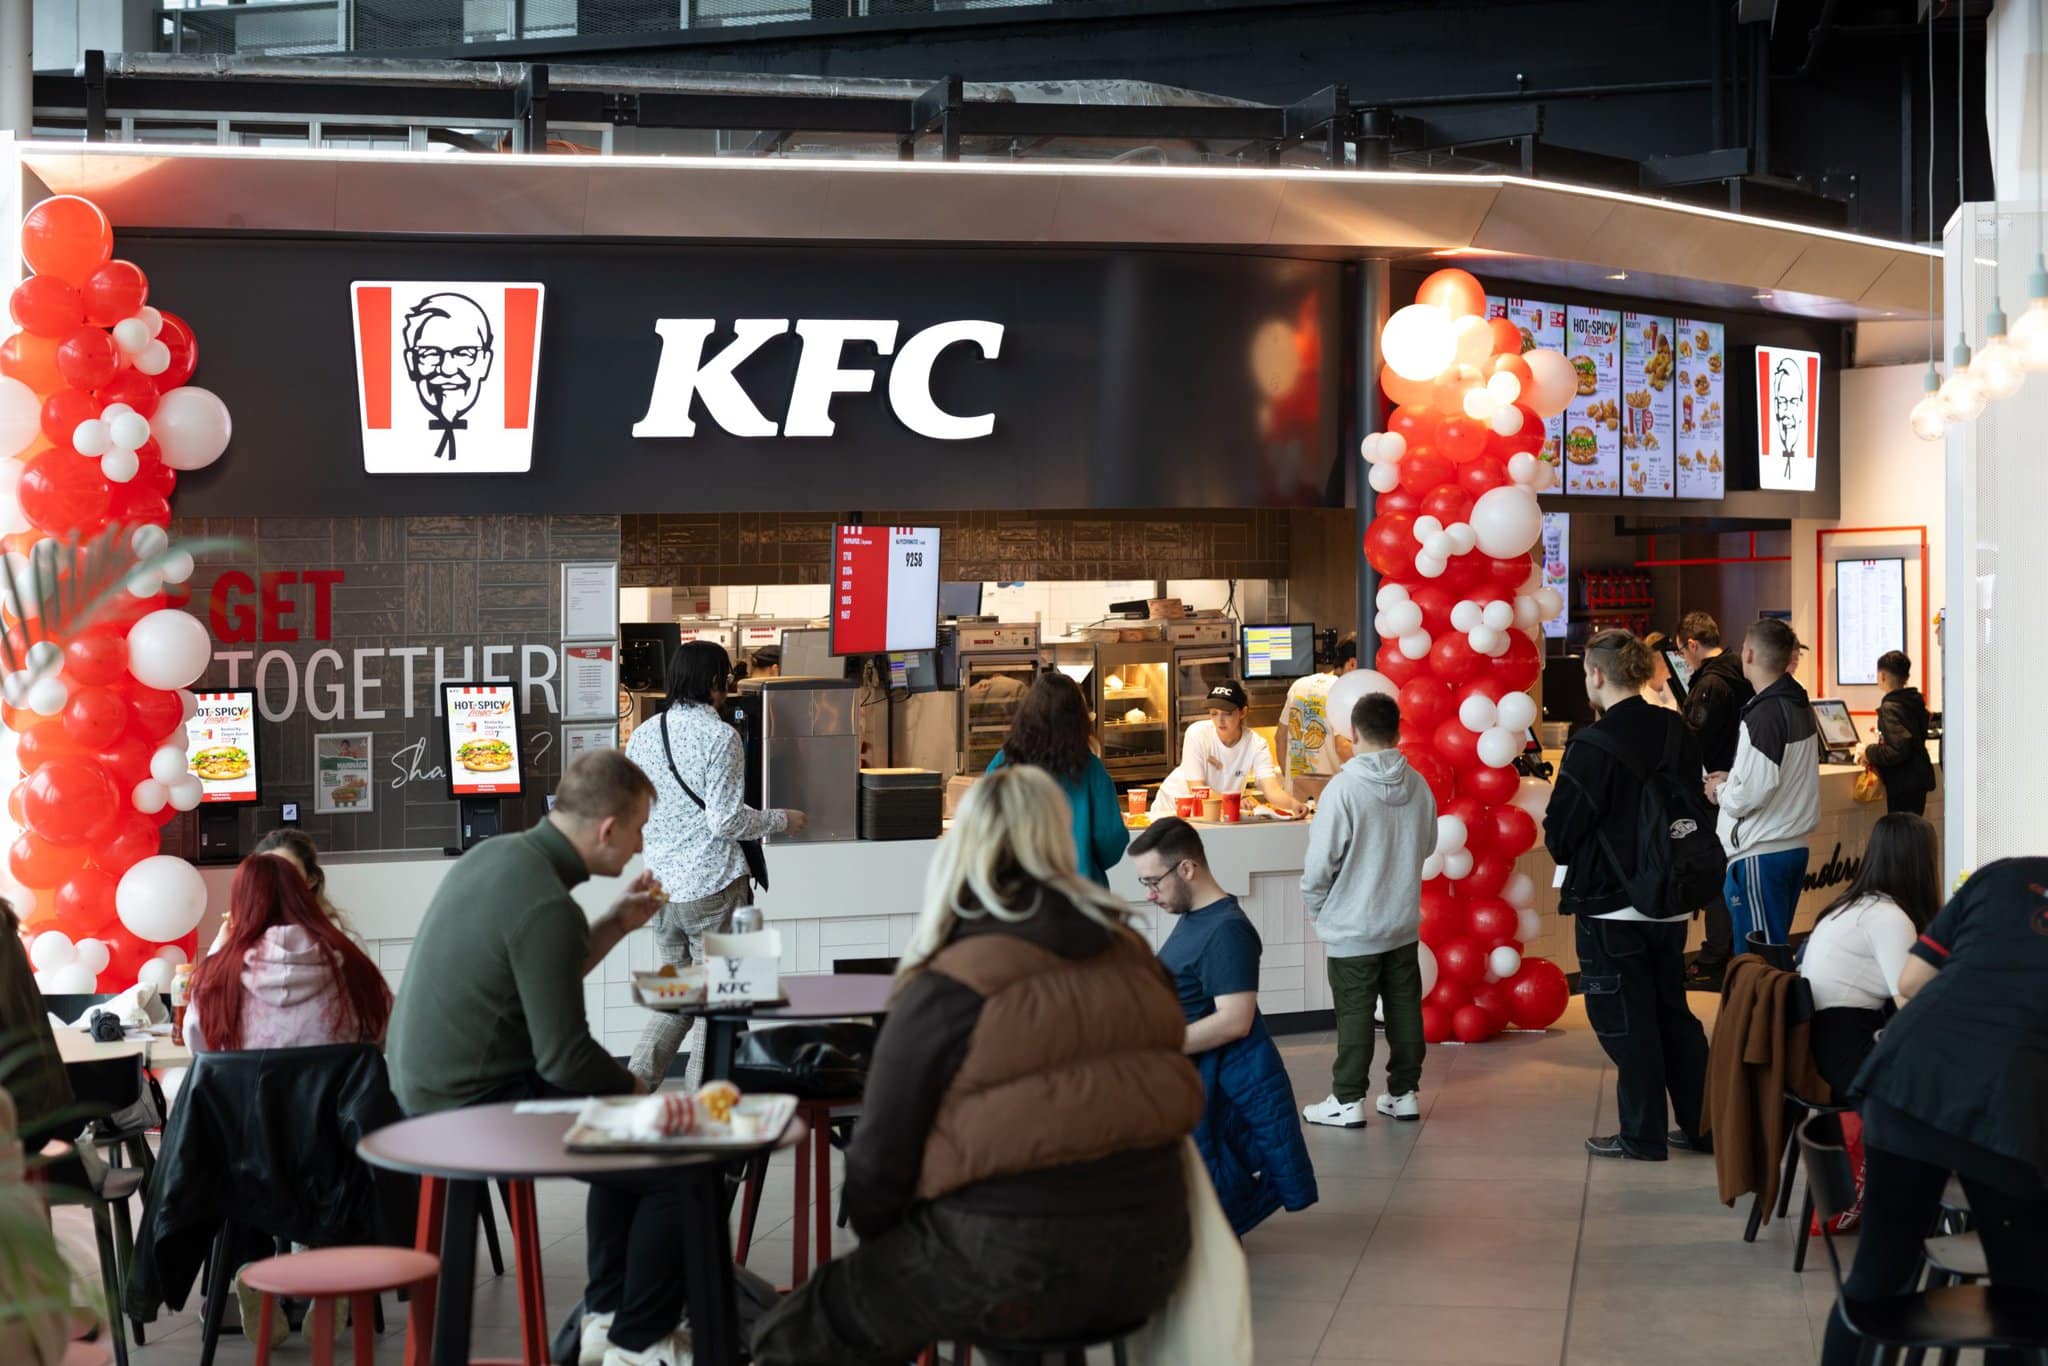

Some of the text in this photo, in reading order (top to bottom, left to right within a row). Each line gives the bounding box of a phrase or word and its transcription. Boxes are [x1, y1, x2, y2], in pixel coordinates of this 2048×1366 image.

[632, 318, 1004, 439] KFC
[905, 552, 923, 567] 9258
[209, 570, 345, 643] GET
[213, 644, 560, 723] TOGETHER
[1211, 686, 1233, 697] KFC
[717, 981, 751, 994] KFC
